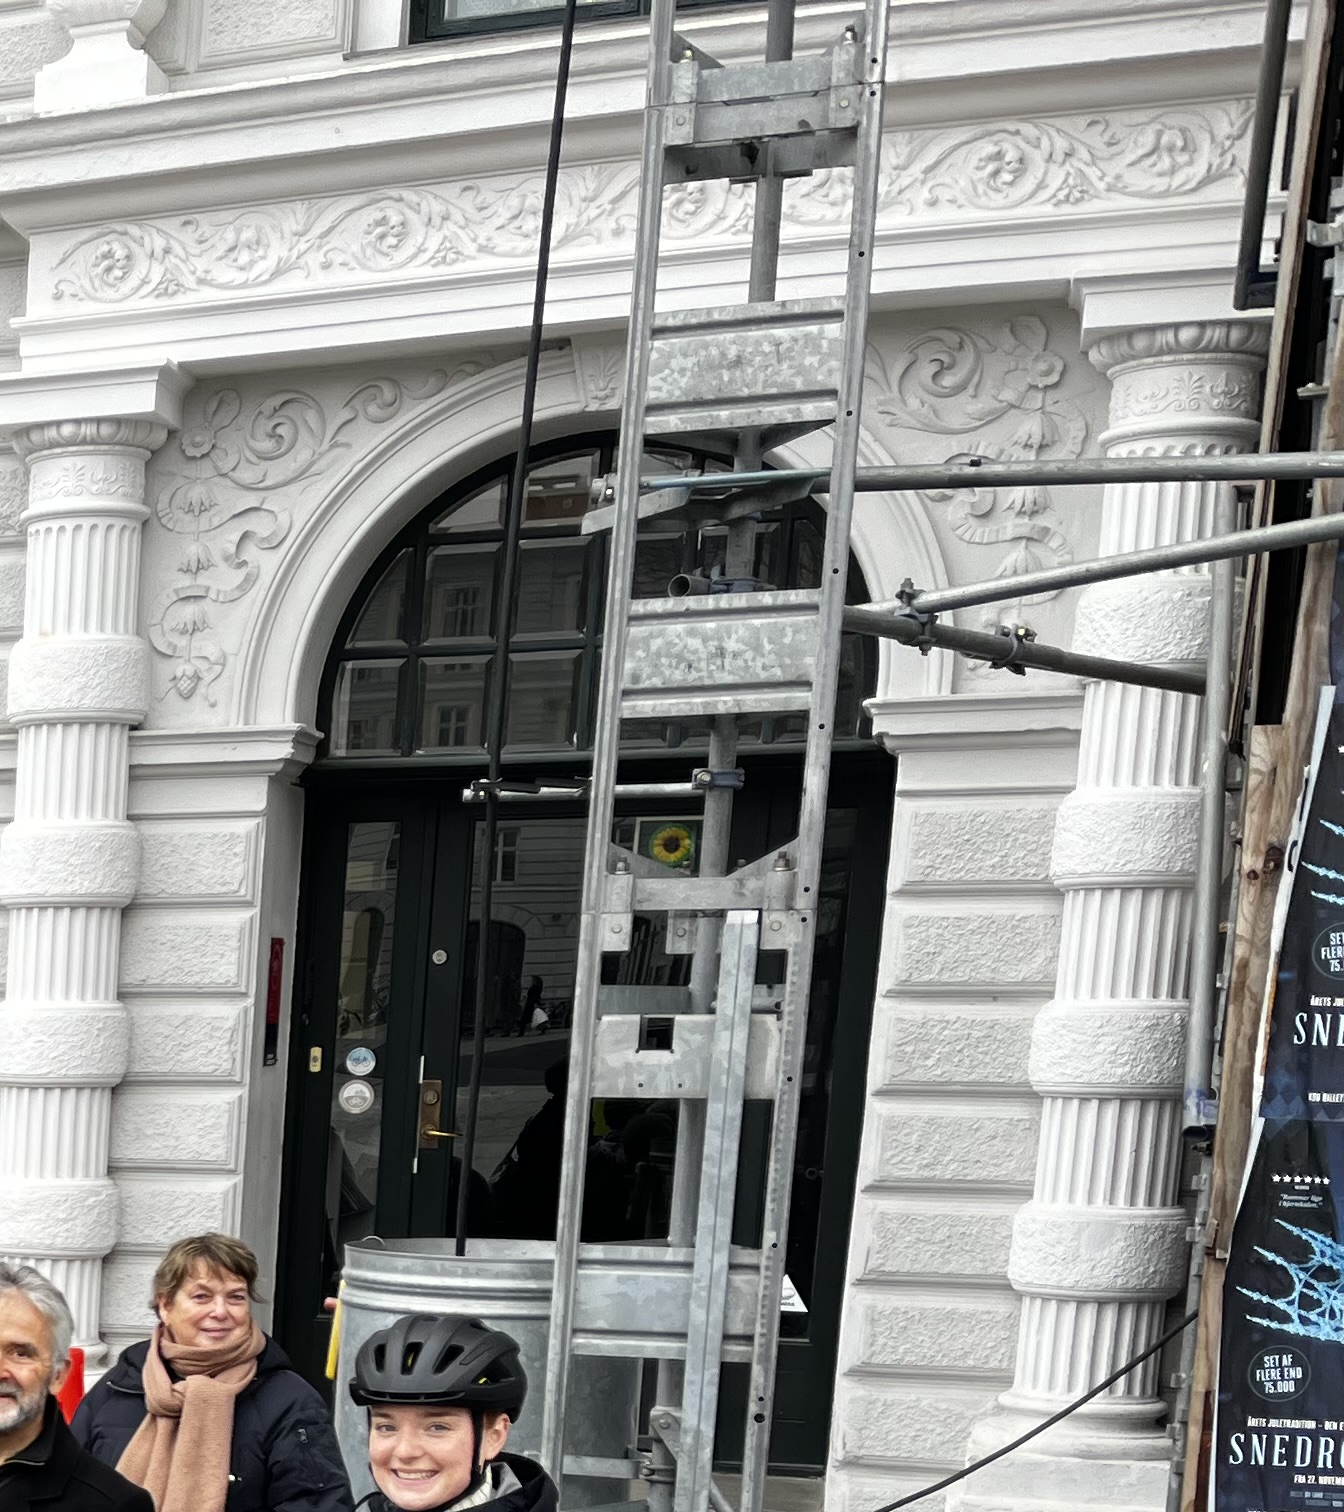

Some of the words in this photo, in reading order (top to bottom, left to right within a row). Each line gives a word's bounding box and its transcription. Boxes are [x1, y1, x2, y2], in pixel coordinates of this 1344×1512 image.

[1321, 946, 1344, 960] FLER
[1329, 959, 1344, 972] 75.
[1263, 1354, 1279, 1368] SET
[1282, 1354, 1293, 1366] AF
[1255, 1368, 1282, 1382] FLERE
[1284, 1366, 1303, 1380] END
[1264, 1380, 1296, 1393] 75.000
[1229, 1432, 1344, 1469] SNEDR
